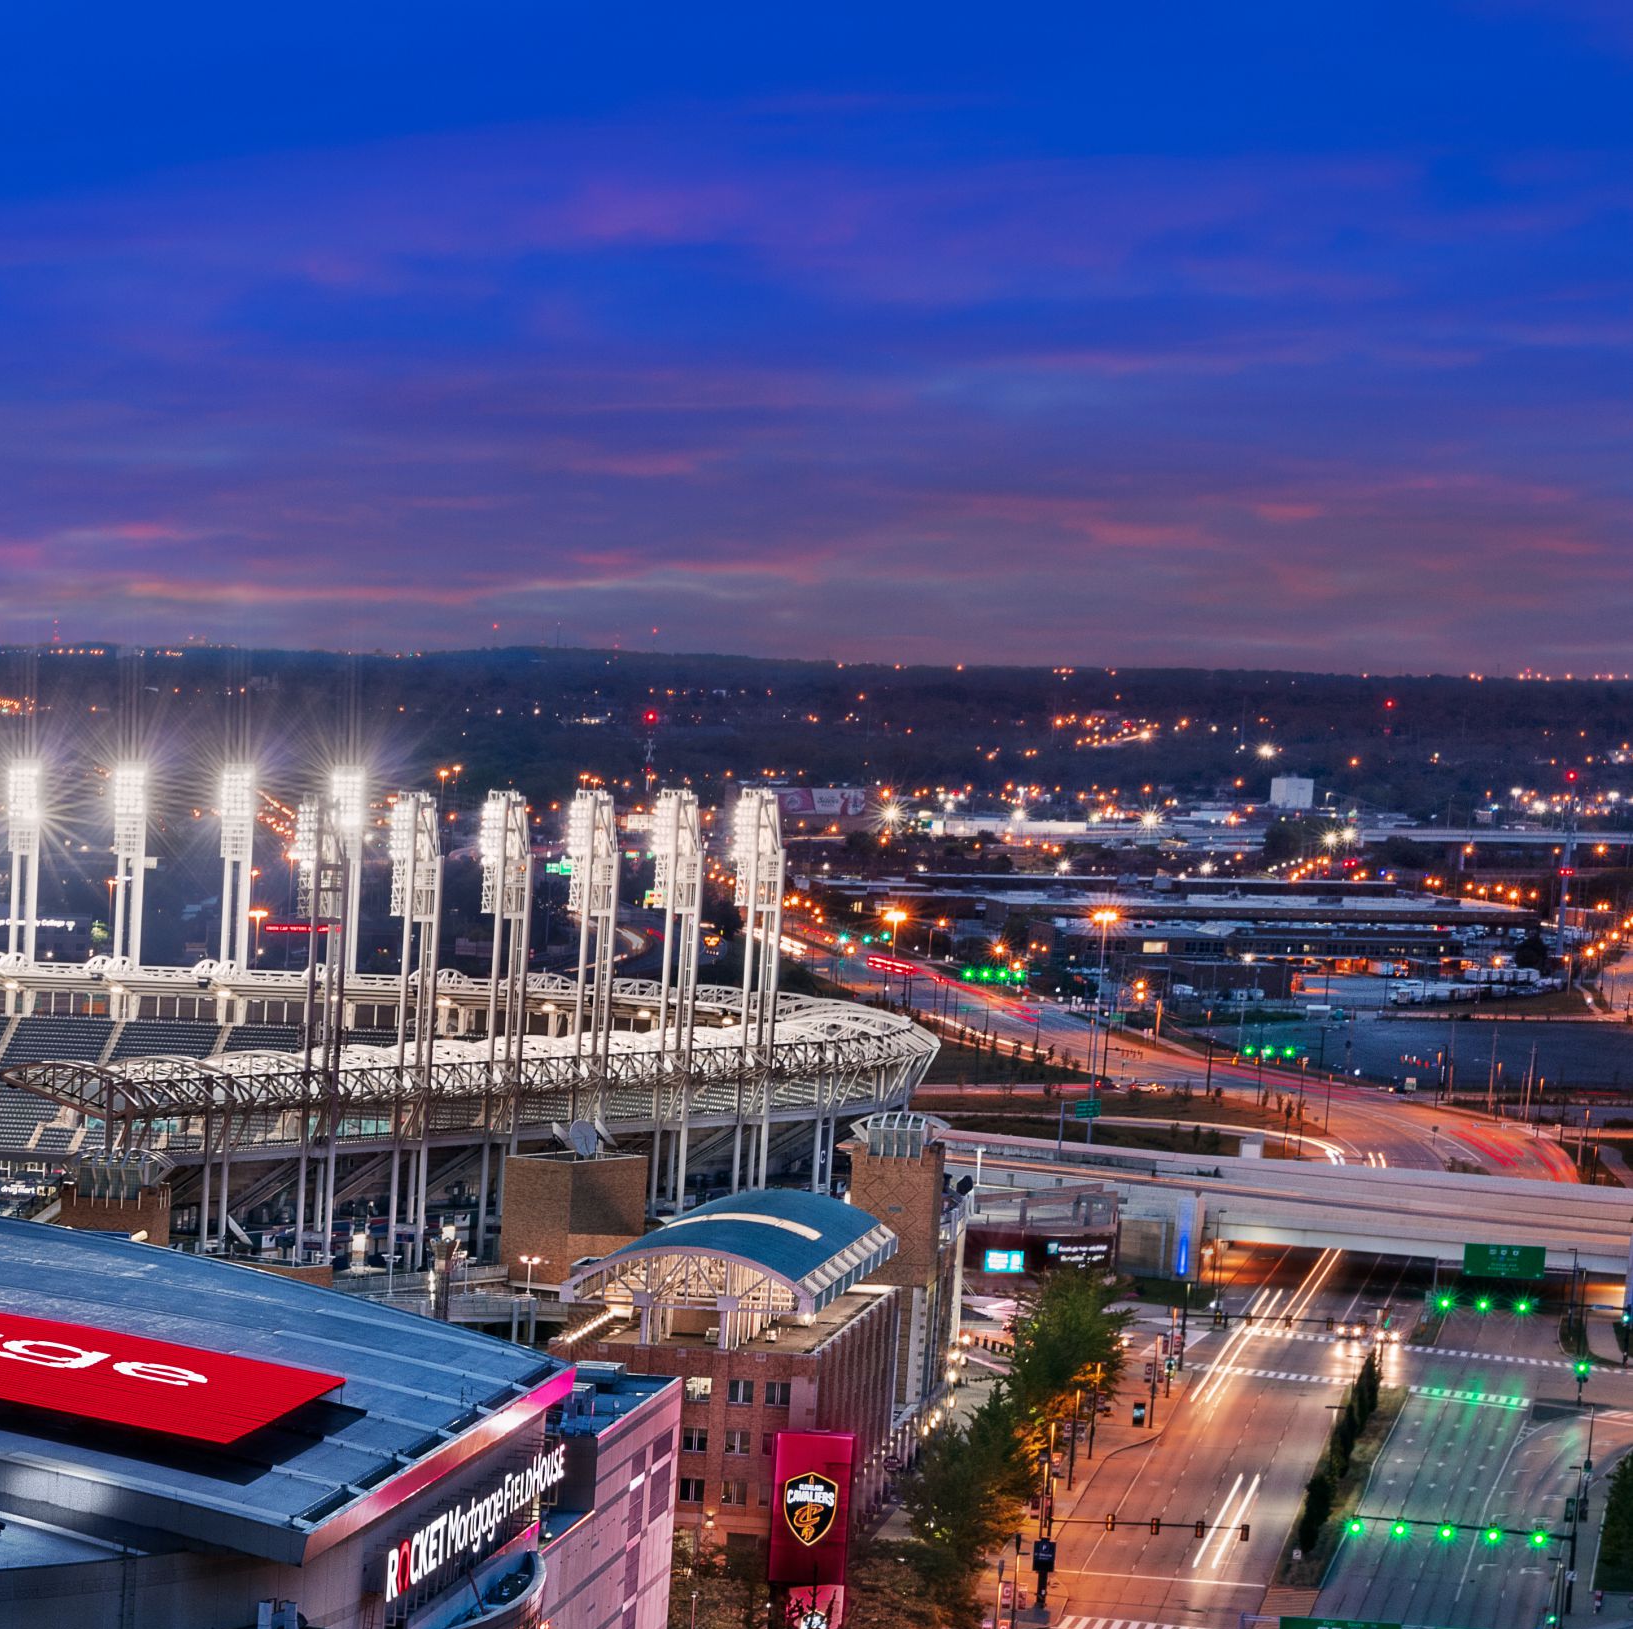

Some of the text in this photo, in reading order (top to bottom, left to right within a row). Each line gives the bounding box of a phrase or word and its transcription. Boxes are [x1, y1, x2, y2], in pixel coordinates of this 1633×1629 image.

[1, 1185, 18, 1195] drug
[18, 1186, 35, 1194] mart
[786, 1489, 836, 1507] CAVALIERS
[386, 1443, 566, 1603] ROCKET Mortgage FIELDHOUSE
[1003, 1587, 1011, 1596] C
